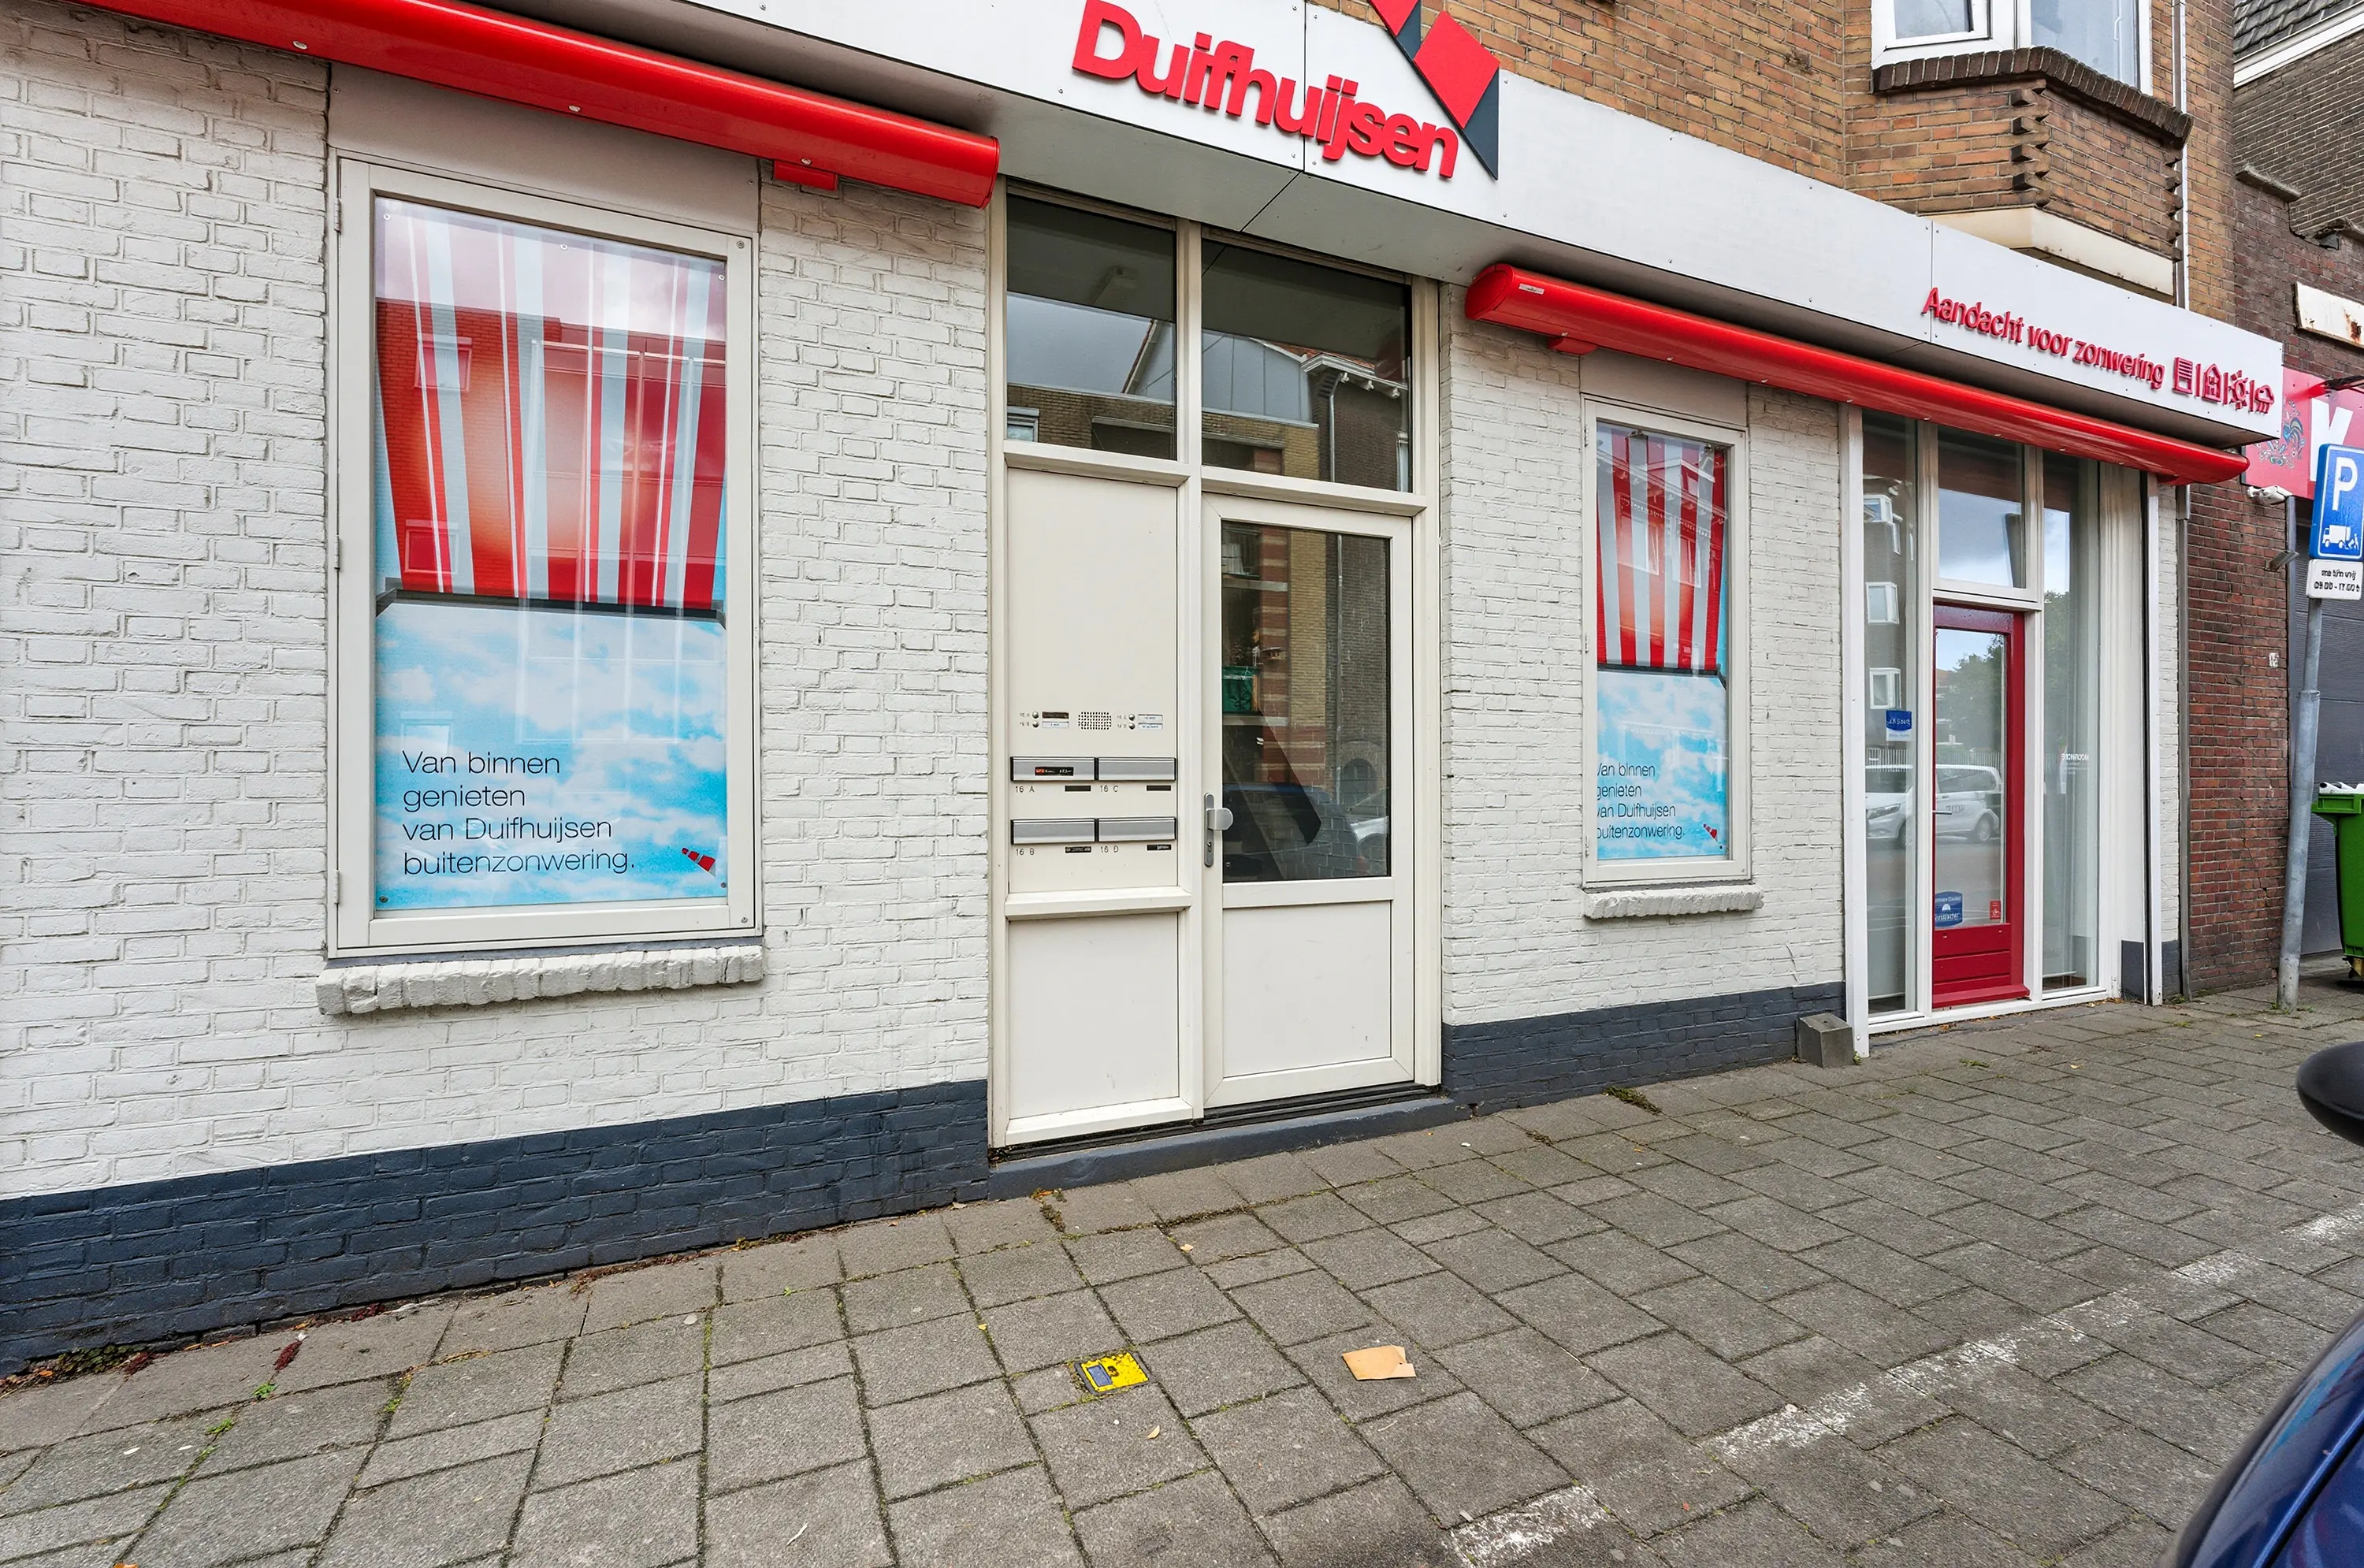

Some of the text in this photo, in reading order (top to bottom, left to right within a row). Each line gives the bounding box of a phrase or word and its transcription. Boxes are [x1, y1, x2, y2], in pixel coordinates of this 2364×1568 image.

[1072, 0, 1459, 179] Duifhuijsen
[1922, 287, 2165, 391] Aandacht voor zonwering
[2332, 456, 2358, 511] P
[402, 750, 560, 775] Van binnen
[1619, 762, 1656, 777] binnen
[403, 784, 526, 812] genieten
[1618, 803, 1676, 820] Duifhuijsen
[402, 816, 612, 843] van Duifhuijsen
[403, 849, 635, 875] buitenzonwering.
